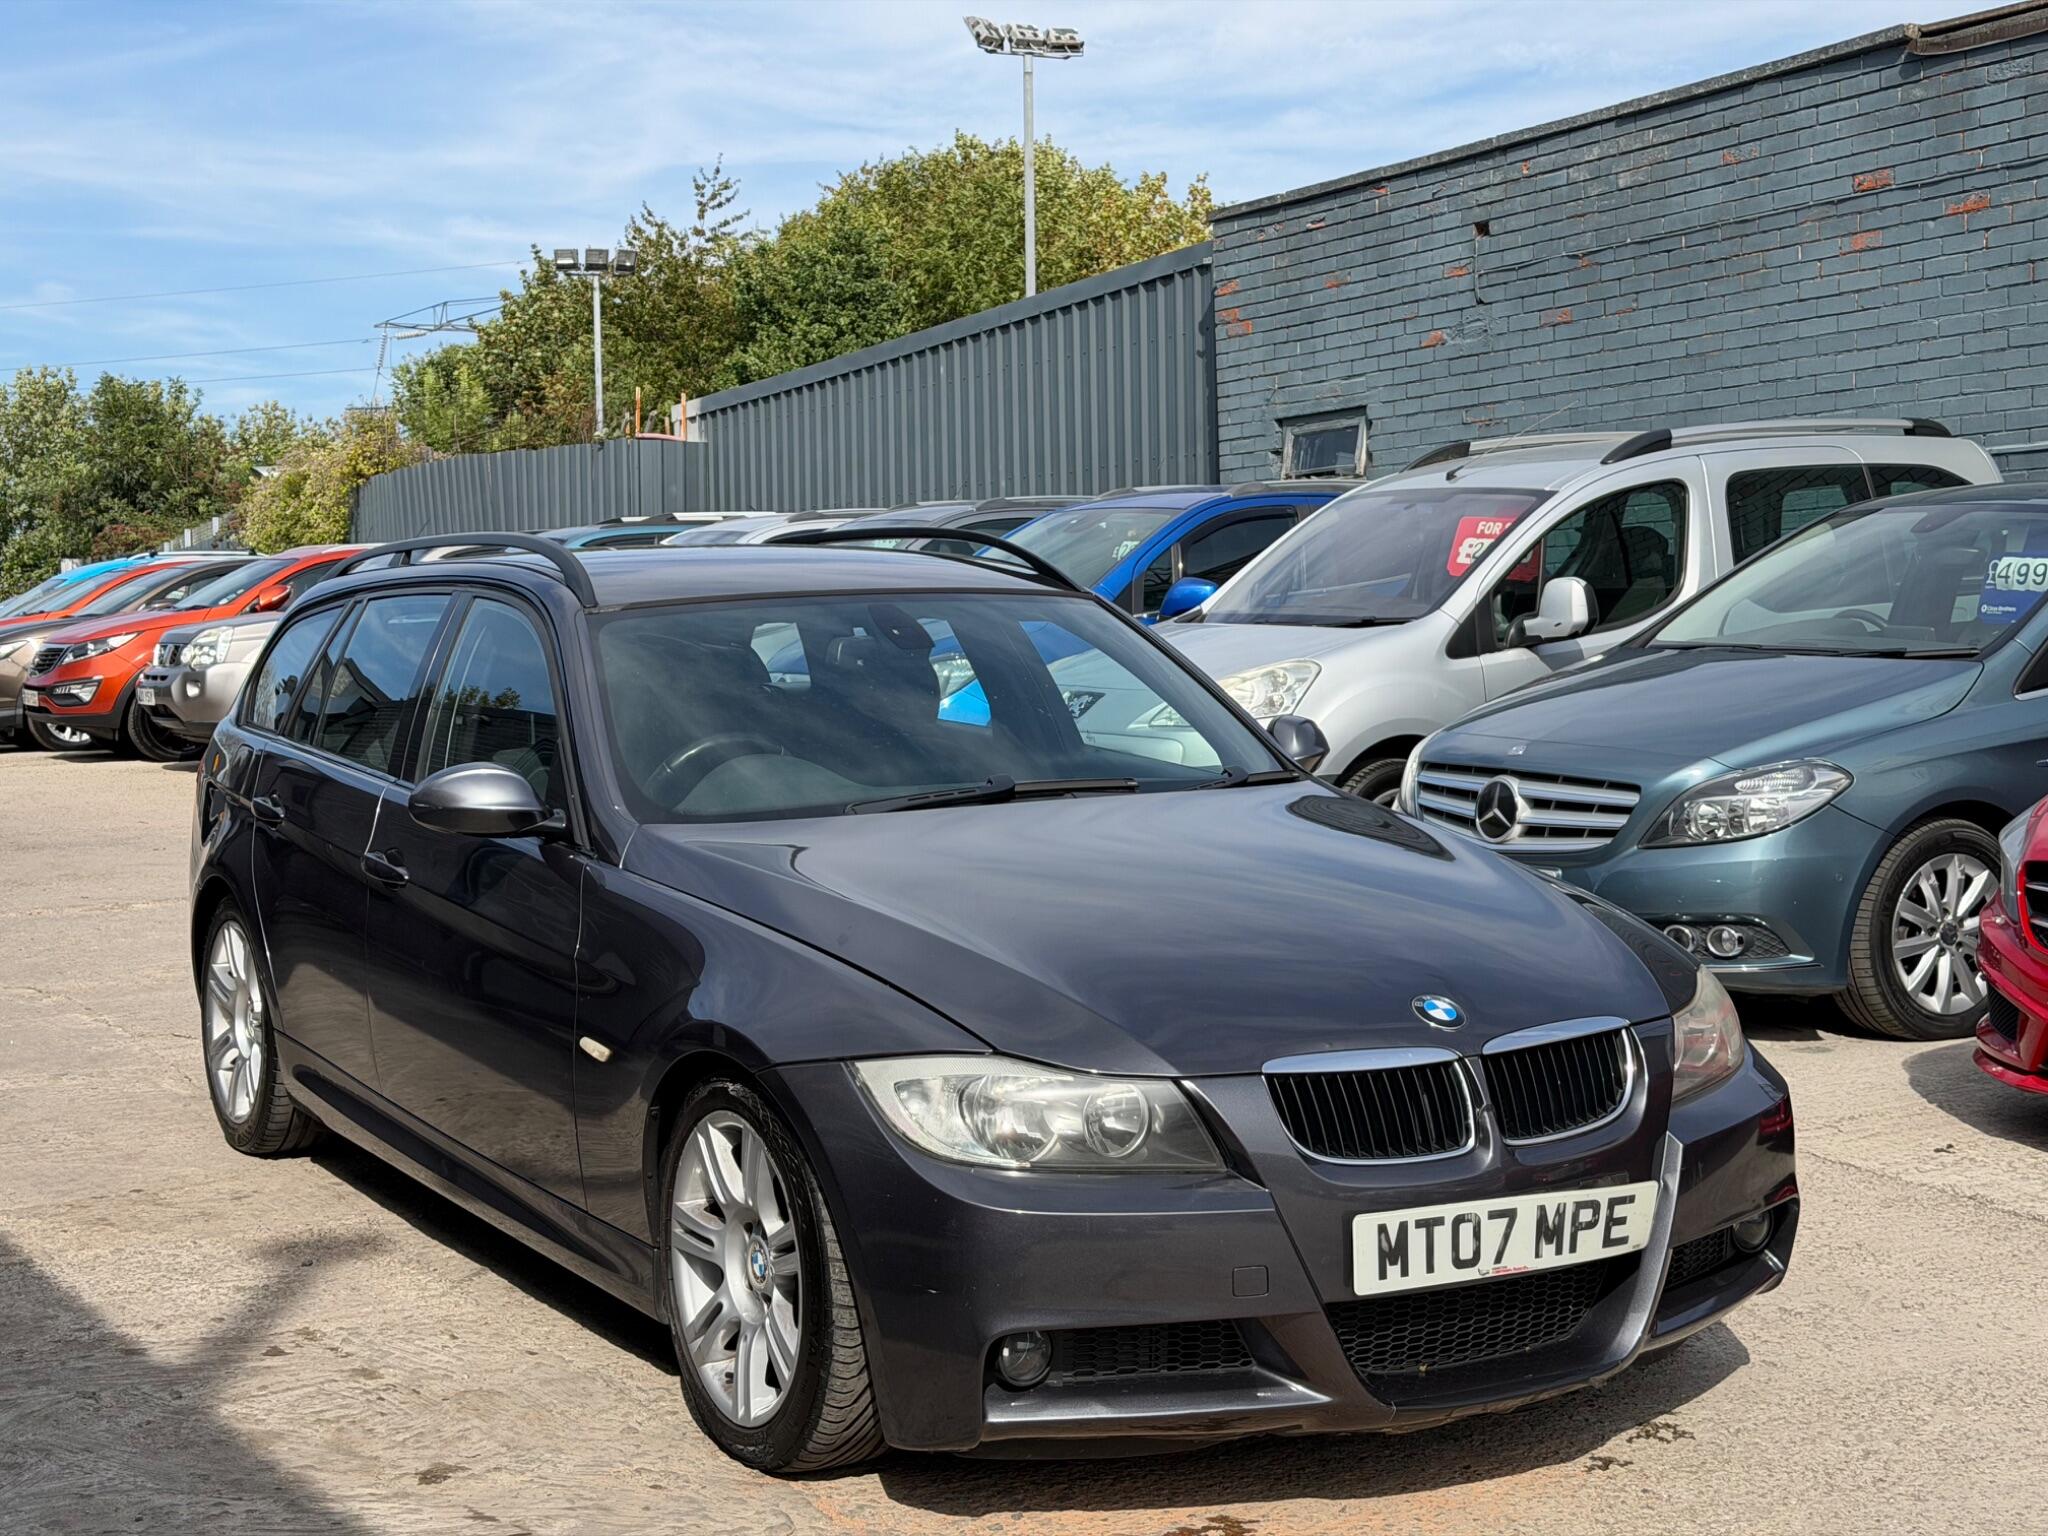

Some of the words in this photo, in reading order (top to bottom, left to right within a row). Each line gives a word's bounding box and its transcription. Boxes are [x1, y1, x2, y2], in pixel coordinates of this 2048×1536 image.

[1476, 521, 1502, 535] FOR
[1377, 1207, 1518, 1281] MT07
[1535, 1194, 1636, 1259] MPE
